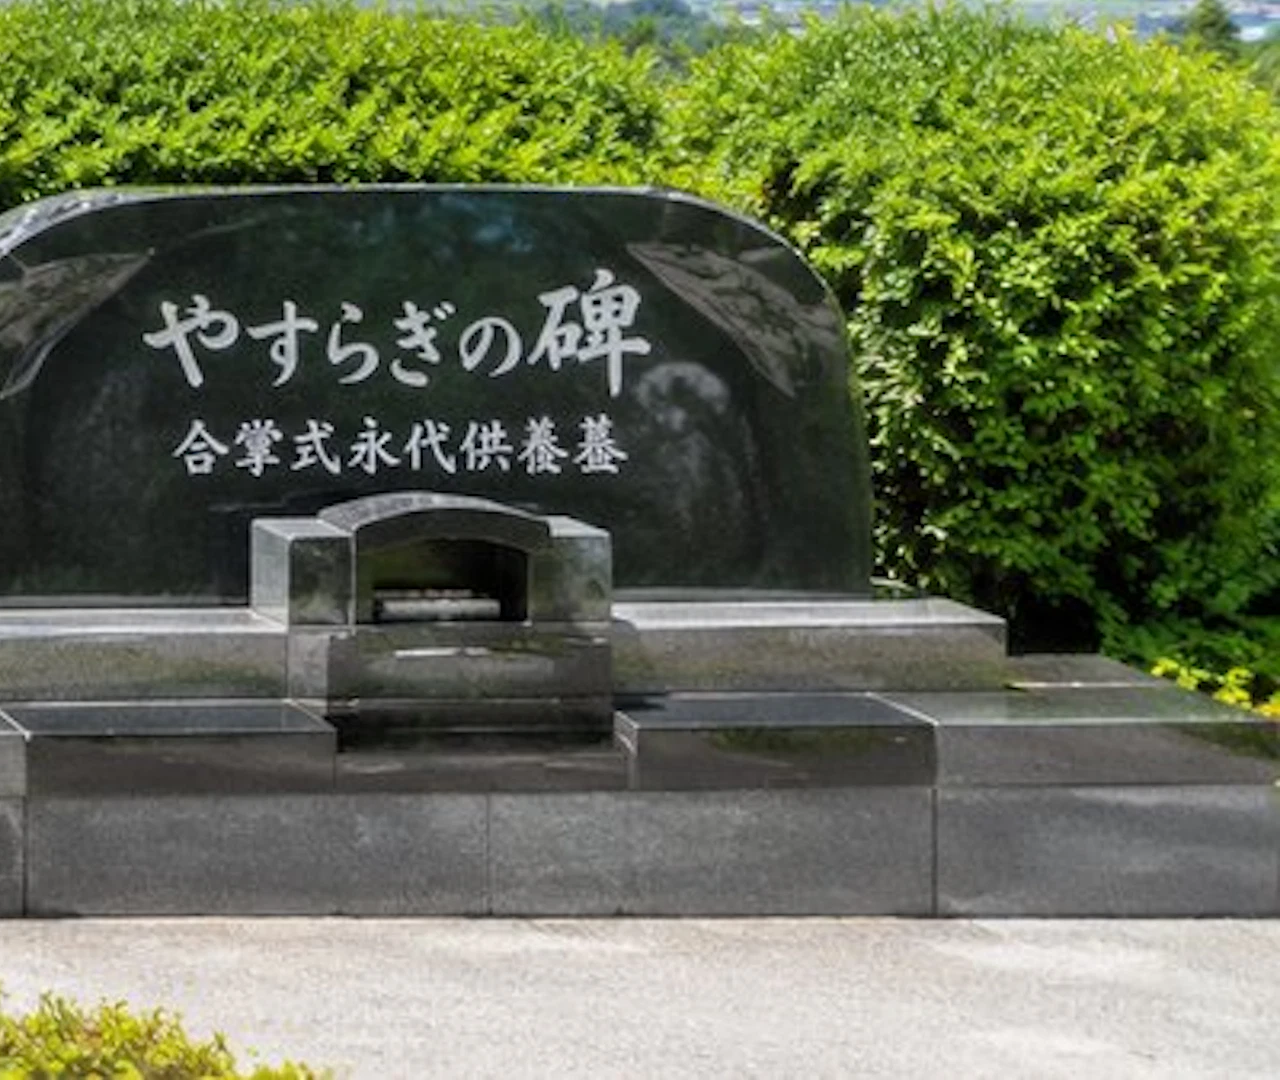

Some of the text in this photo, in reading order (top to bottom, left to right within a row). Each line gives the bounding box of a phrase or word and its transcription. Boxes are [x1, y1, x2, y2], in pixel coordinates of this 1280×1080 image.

[142, 267, 652, 398] やすらぎの碑
